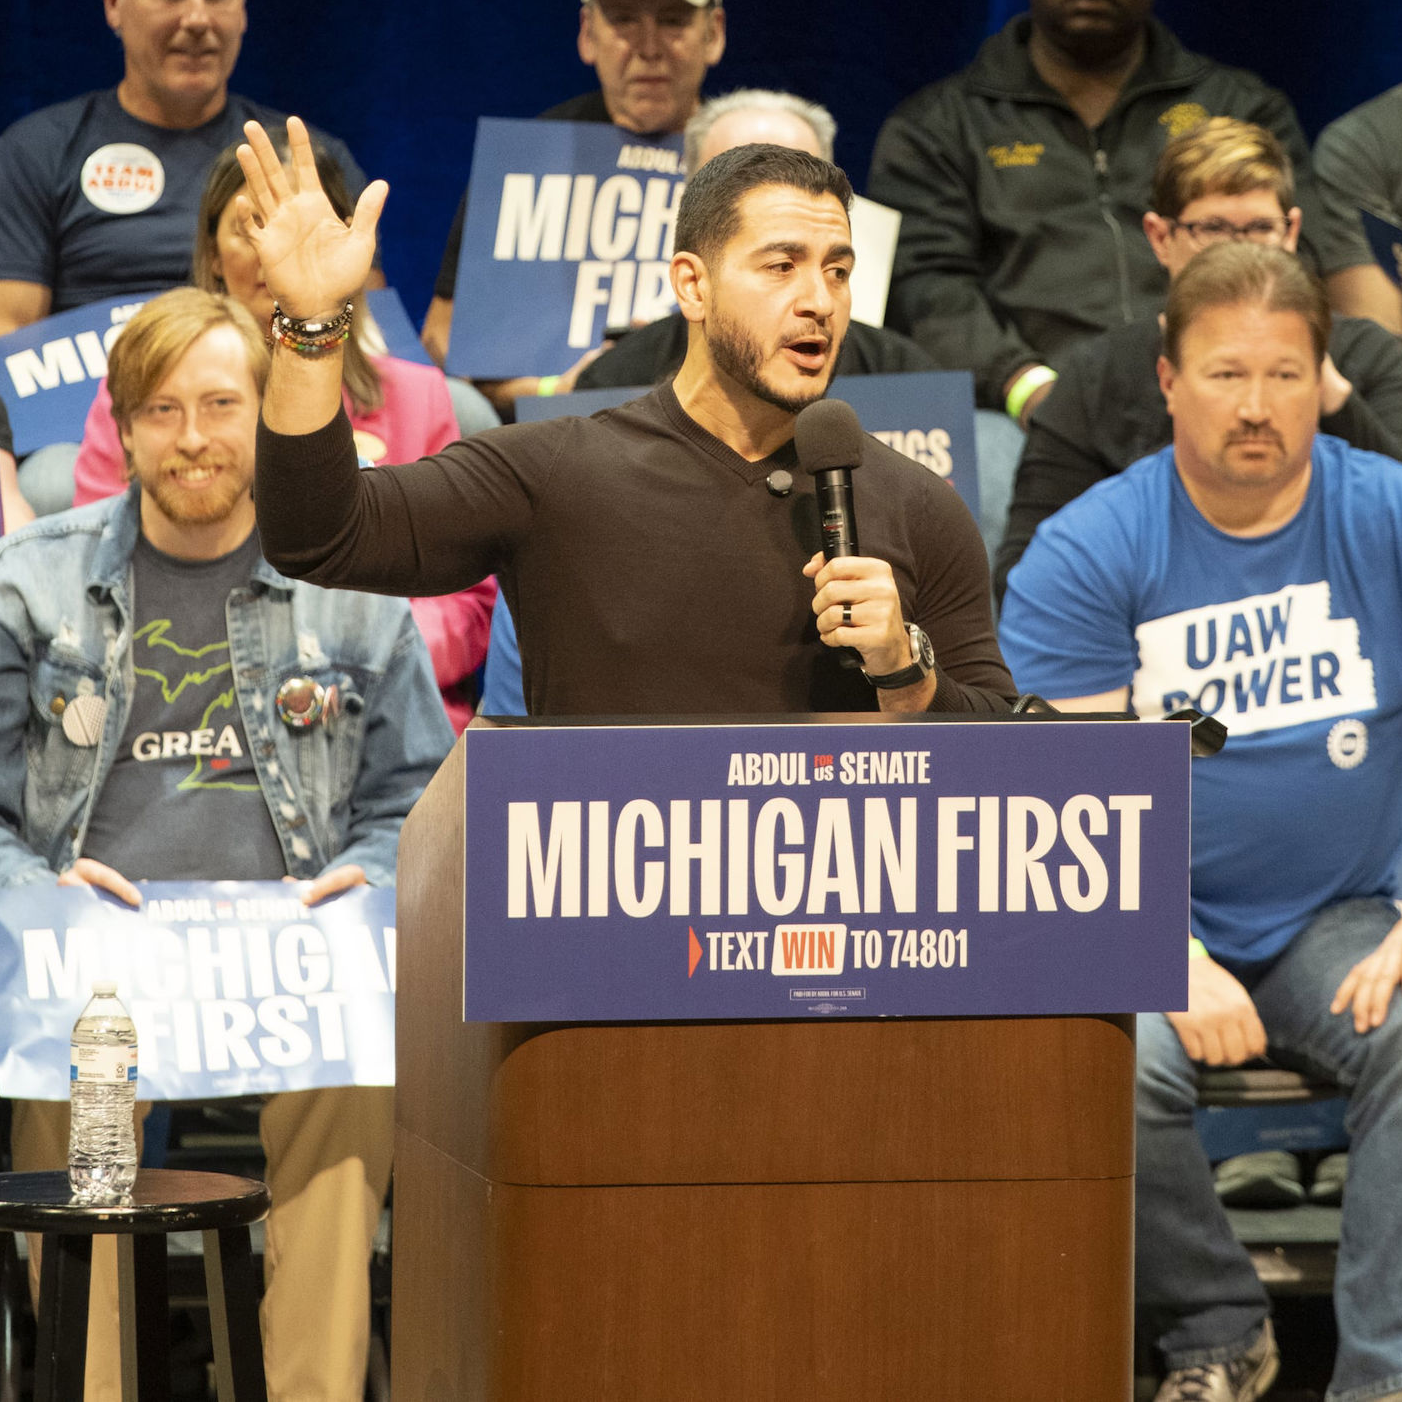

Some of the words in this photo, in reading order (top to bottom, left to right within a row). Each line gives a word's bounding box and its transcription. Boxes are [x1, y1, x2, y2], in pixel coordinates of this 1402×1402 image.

[1185, 595, 1293, 671] UAW
[132, 724, 244, 762] GREA
[814, 754, 834, 767] FOR
[727, 752, 811, 786] ABDUL
[814, 765, 834, 782] US
[839, 751, 931, 785] SENATE
[507, 796, 917, 919] MICHIGAN
[937, 794, 1153, 914] FIRST
[705, 931, 769, 971] TEXT
[781, 930, 835, 969] WIN
[850, 929, 883, 969] TO
[886, 928, 968, 969] 74801
[137, 995, 347, 1074] FIRST
